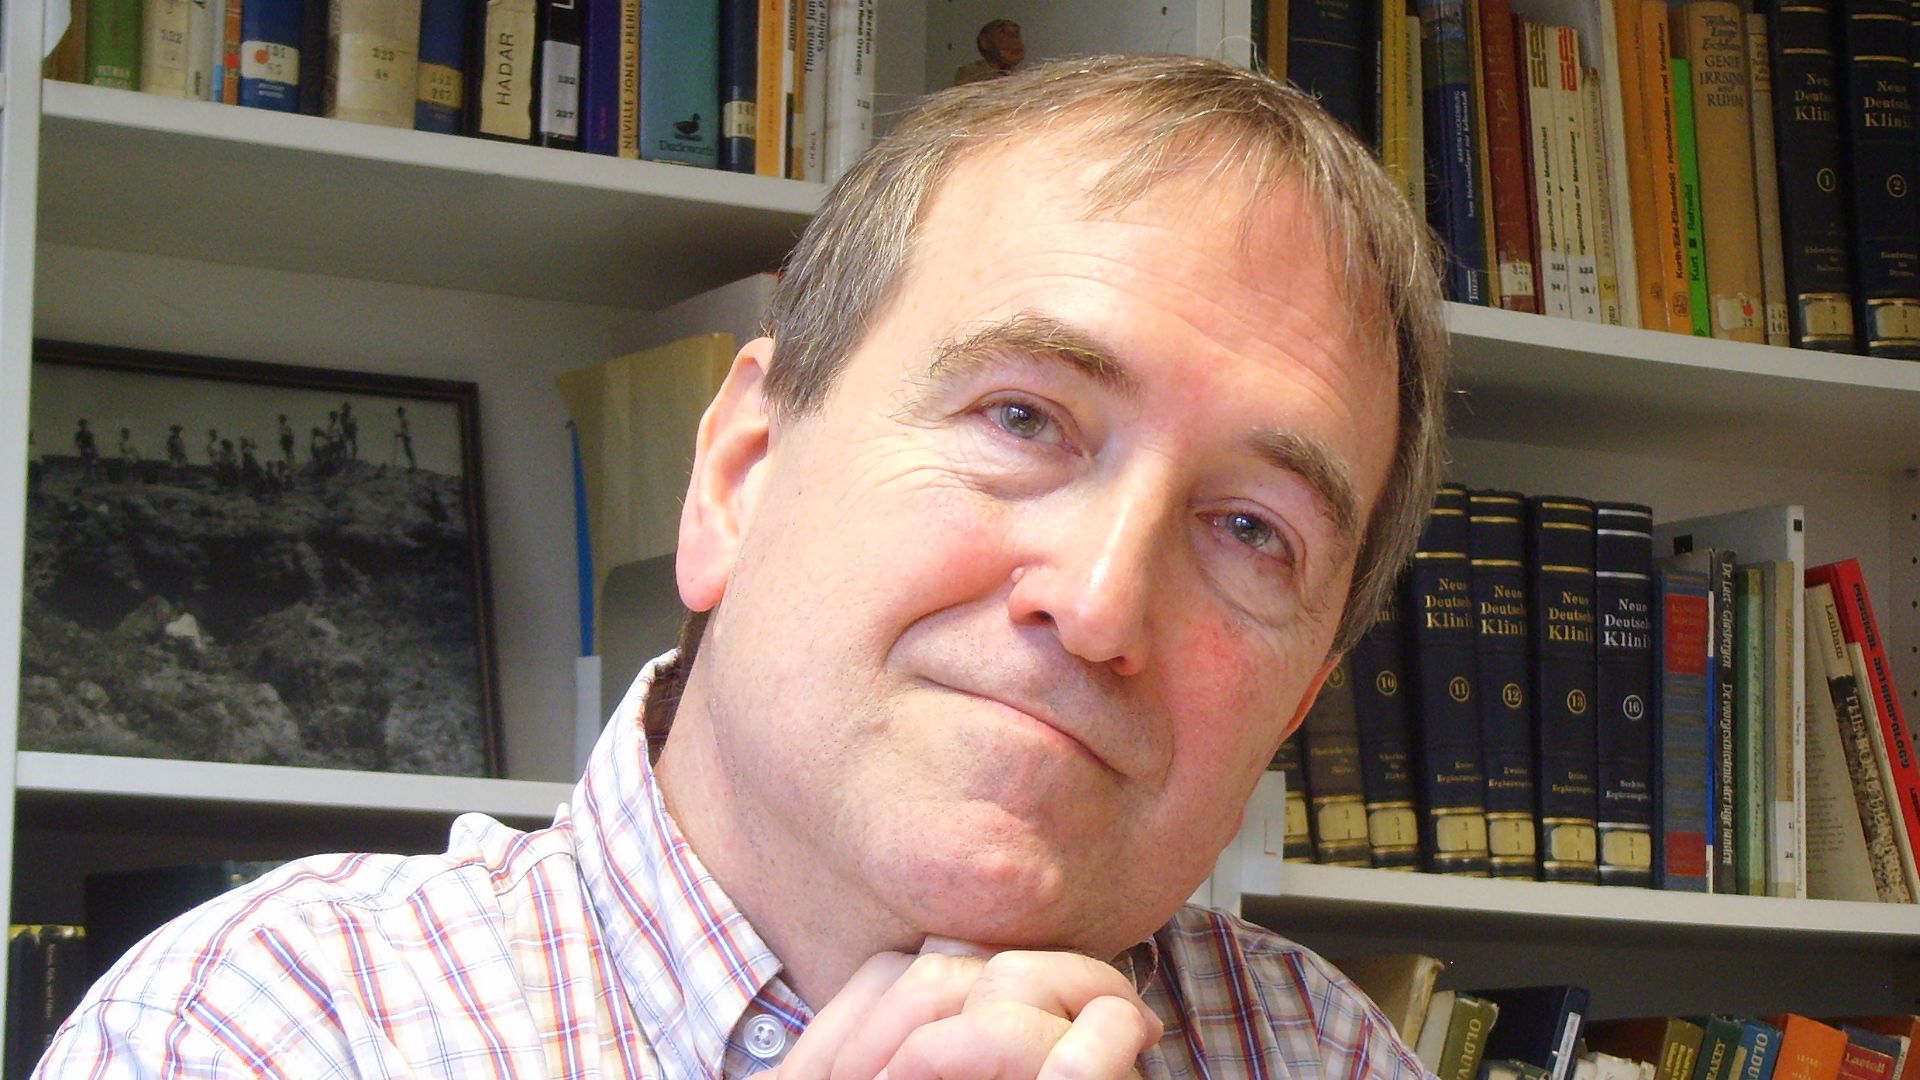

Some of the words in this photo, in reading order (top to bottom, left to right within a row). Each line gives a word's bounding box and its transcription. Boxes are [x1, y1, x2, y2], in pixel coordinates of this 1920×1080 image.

[804, 25, 816, 72] Thomas
[817, 12, 826, 52] Sabine
[1658, 22, 1668, 71] Verhalten
[496, 32, 515, 106] HADAR
[1660, 74, 1669, 94] und
[623, 99, 634, 150] NEVILLE
[1547, 199, 1558, 252] rgeschichte
[1575, 202, 1586, 255] rgeschichte
[1690, 256, 1700, 281] Kurt
[1721, 562, 1733, 577] De
[1720, 609, 1733, 668] Glasbergen
[1825, 603, 1843, 660] Lanham
[1722, 683, 1734, 698] De
[1457, 1018, 1482, 1080] OLDUV
